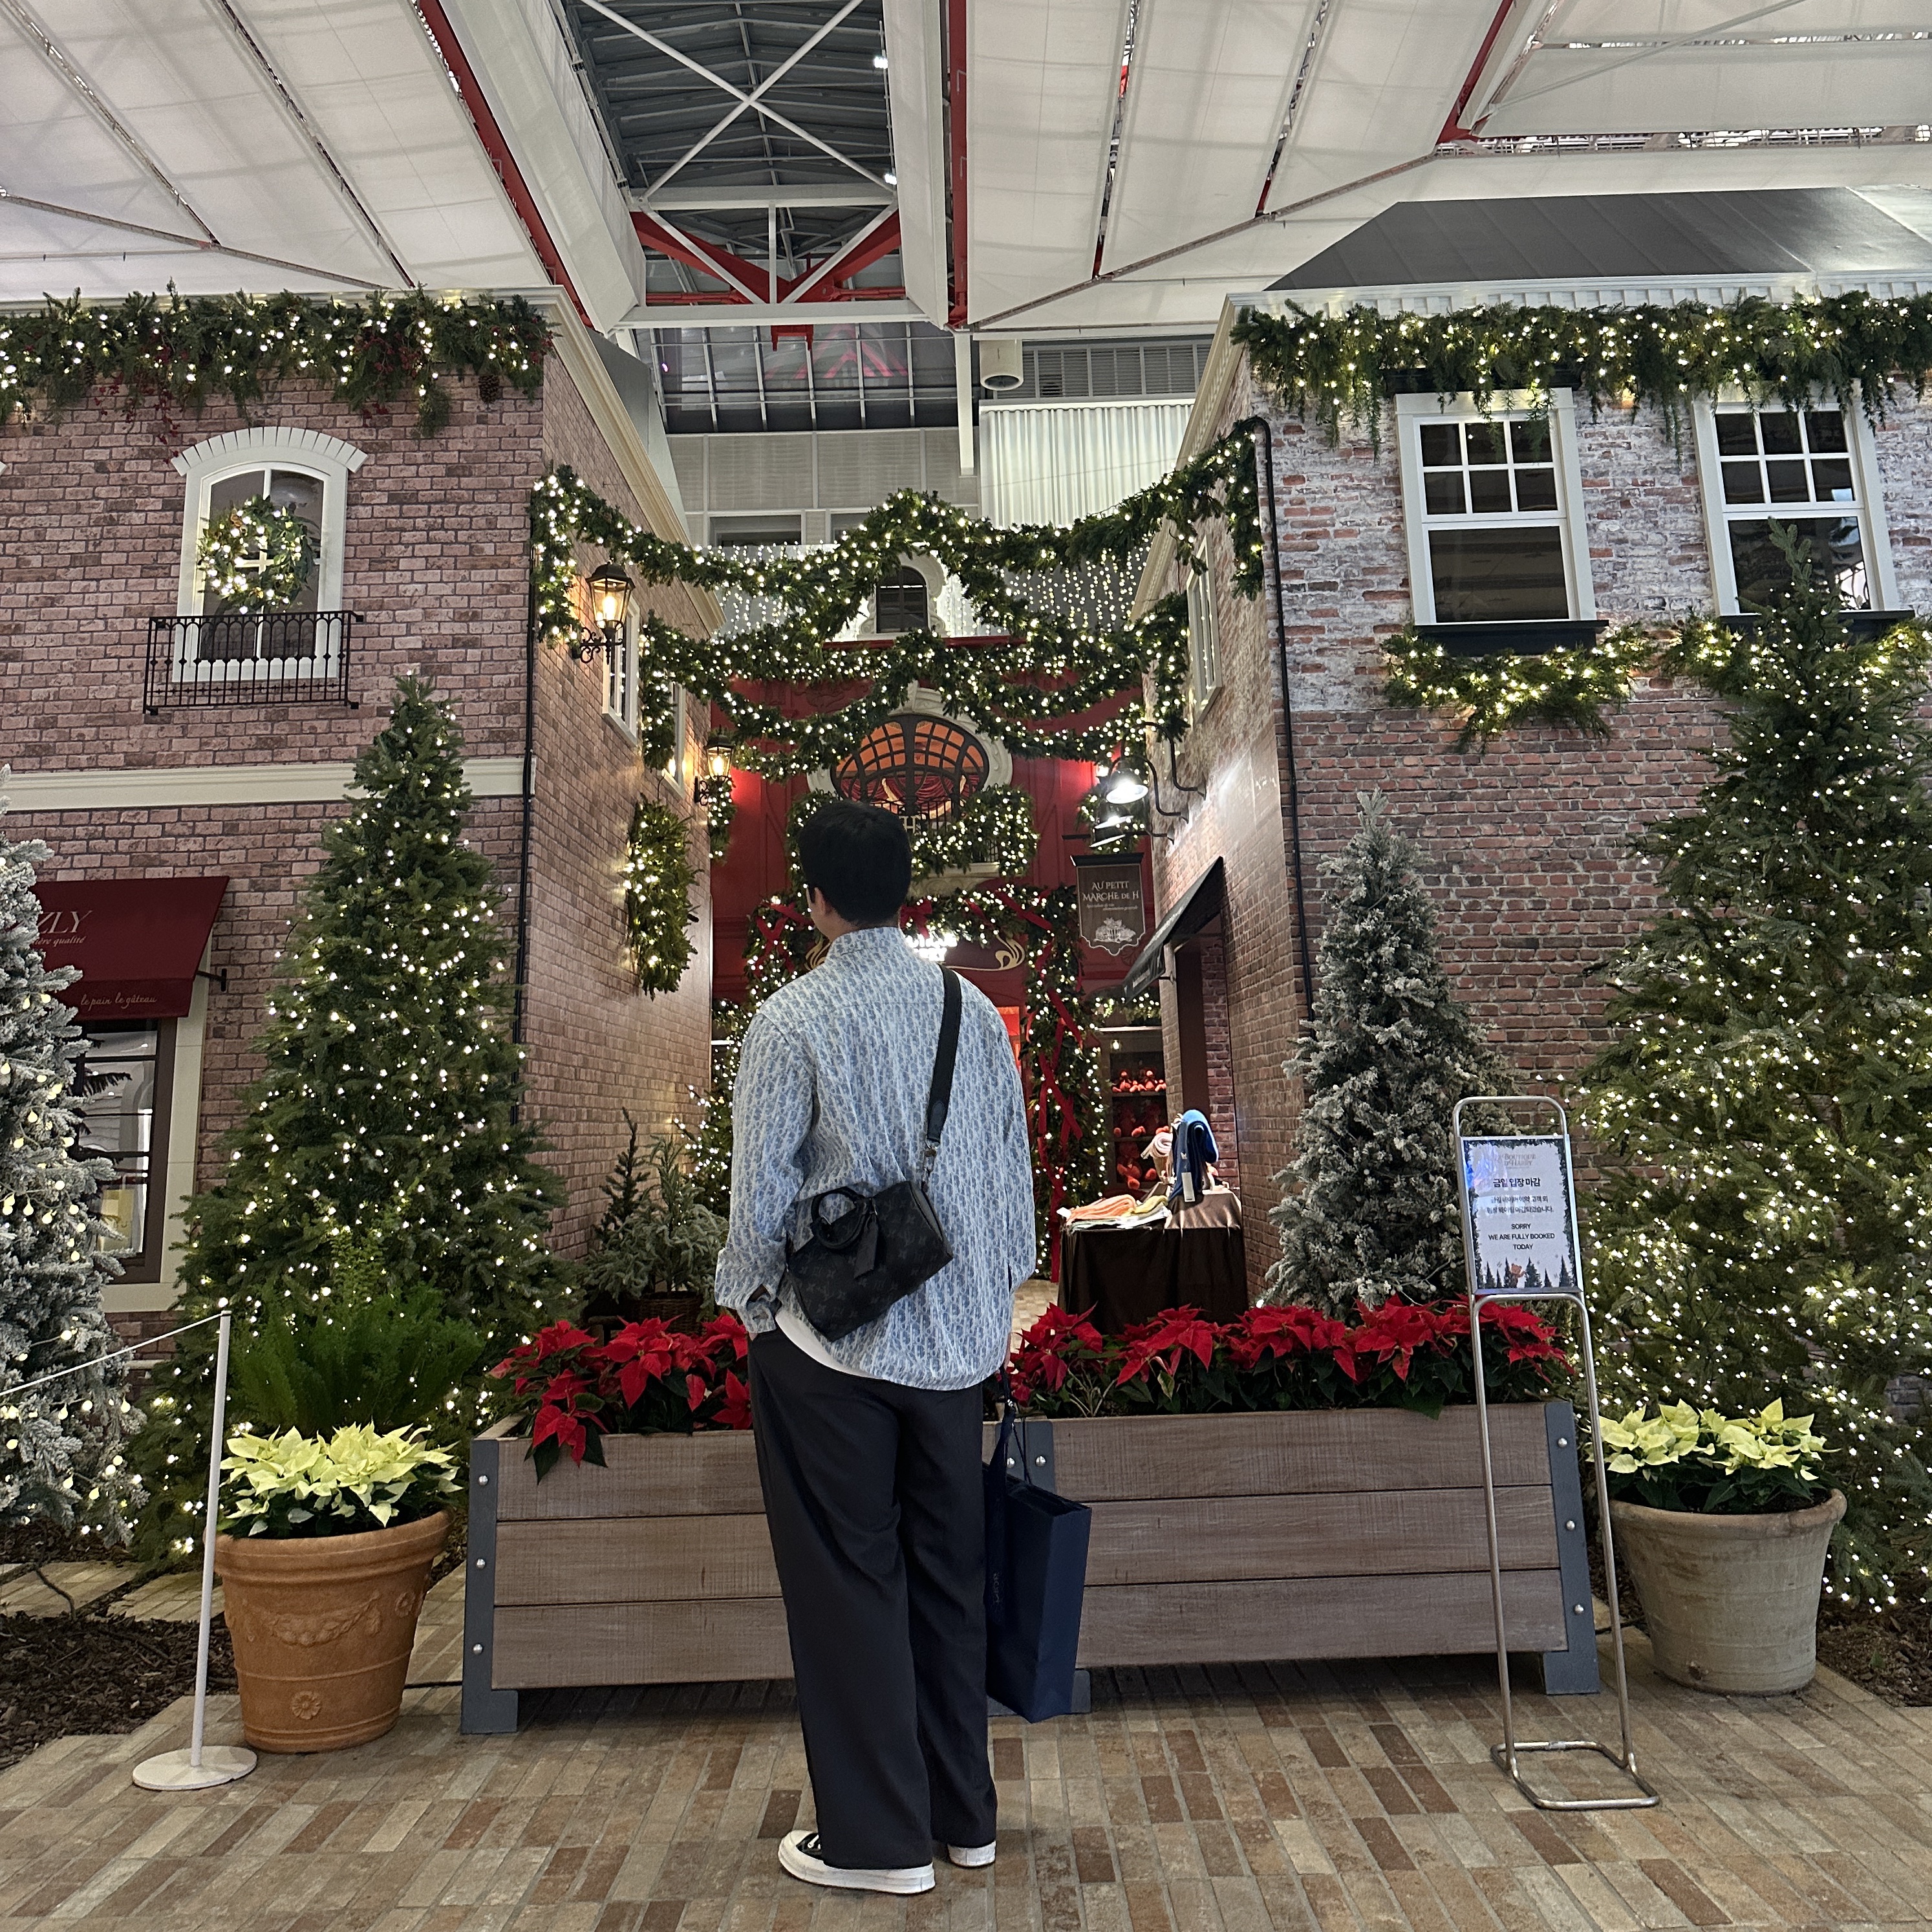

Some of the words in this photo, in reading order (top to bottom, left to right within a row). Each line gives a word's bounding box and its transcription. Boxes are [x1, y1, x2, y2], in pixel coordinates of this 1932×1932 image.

[1091, 881, 1104, 891] AU
[1106, 881, 1129, 890] PETIT
[1082, 892, 1119, 903] MARCHE
[1132, 890, 1139, 899] H
[38, 909, 92, 934] ZLY
[53, 935, 87, 947] qualité
[81, 994, 90, 1005] le
[88, 996, 112, 1011] pain
[115, 992, 125, 1004] le
[120, 994, 156, 1009] gâteau
[1493, 1178, 1508, 1187] 금일
[1509, 1178, 1524, 1187] 입장
[1525, 1177, 1541, 1187] 마감
